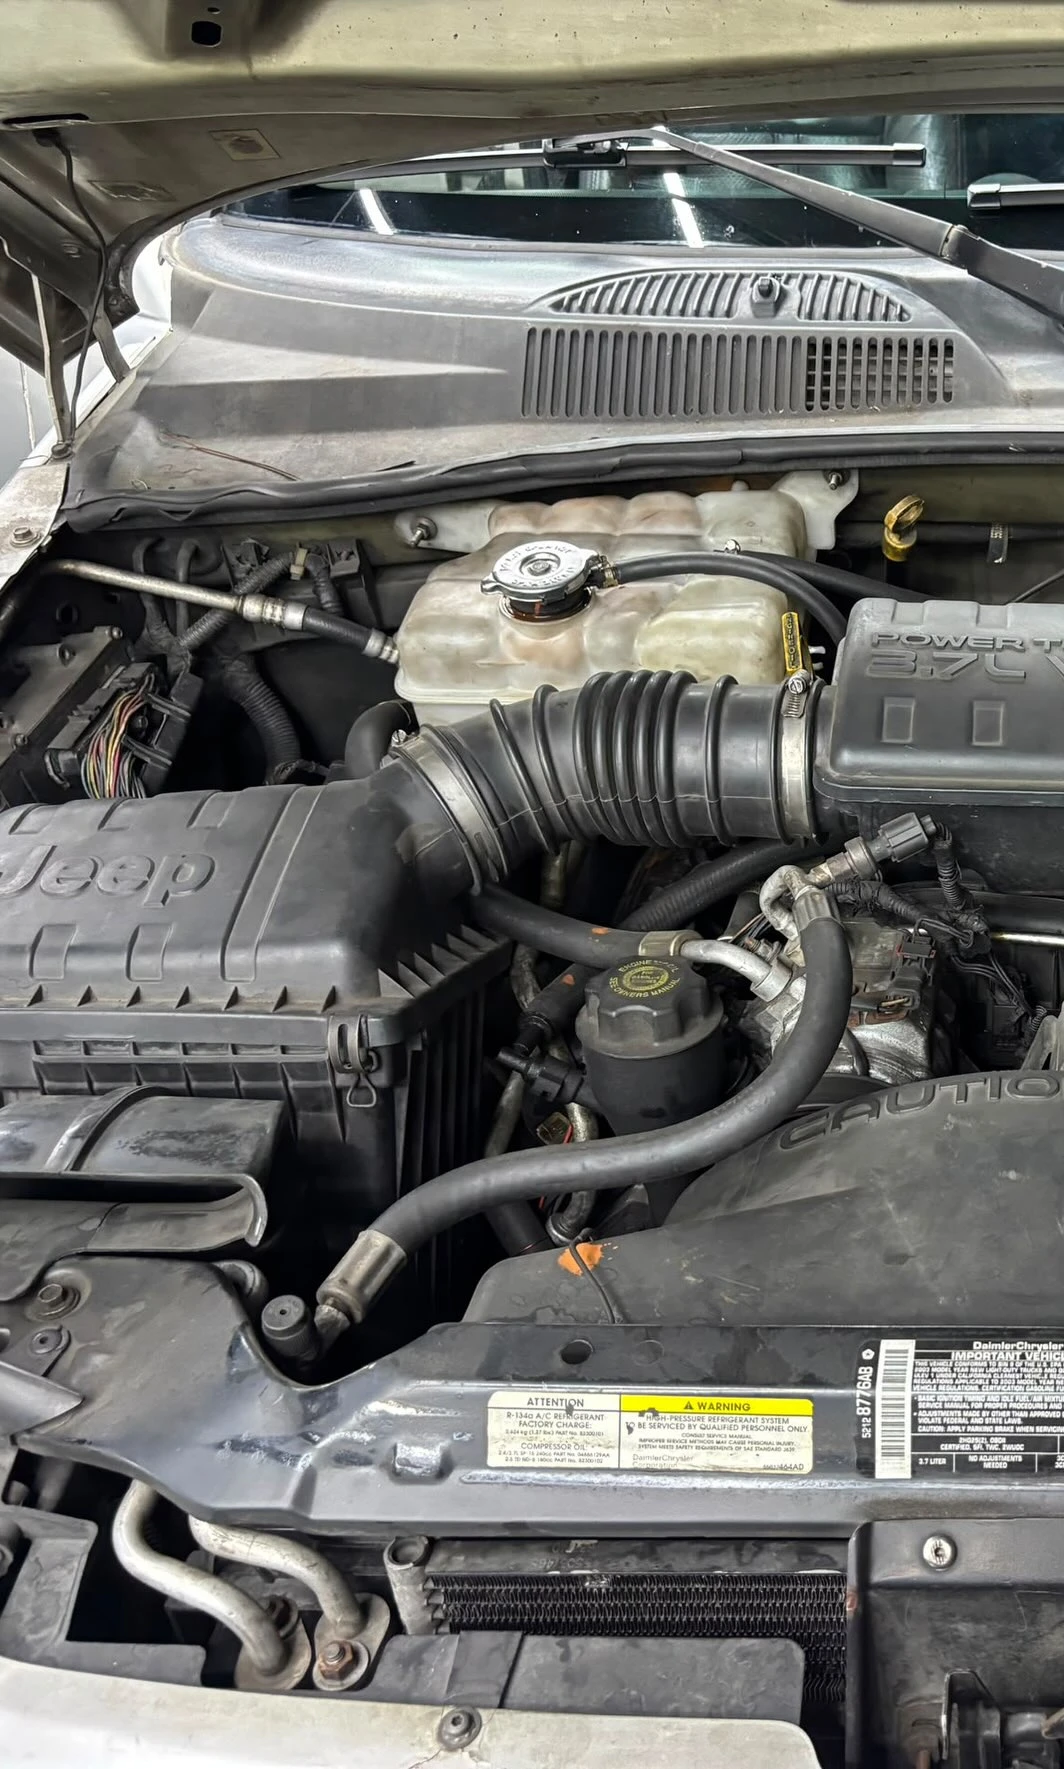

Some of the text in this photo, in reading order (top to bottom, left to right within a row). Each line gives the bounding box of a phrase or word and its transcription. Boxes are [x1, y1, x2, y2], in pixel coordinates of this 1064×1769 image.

[872, 632, 1026, 652] POWER
[865, 650, 1027, 683] 3.7L
[0, 844, 217, 909] Jeep
[973, 1341, 1064, 1352] DaimlerChrysler
[951, 1351, 1020, 1360] IMPORTANT
[527, 1398, 584, 1407] ATTENTION
[697, 1402, 751, 1411] WARNING
[856, 1366, 873, 1438] 5212 8776AB
[554, 1413, 604, 1421] REFRIGERANT
